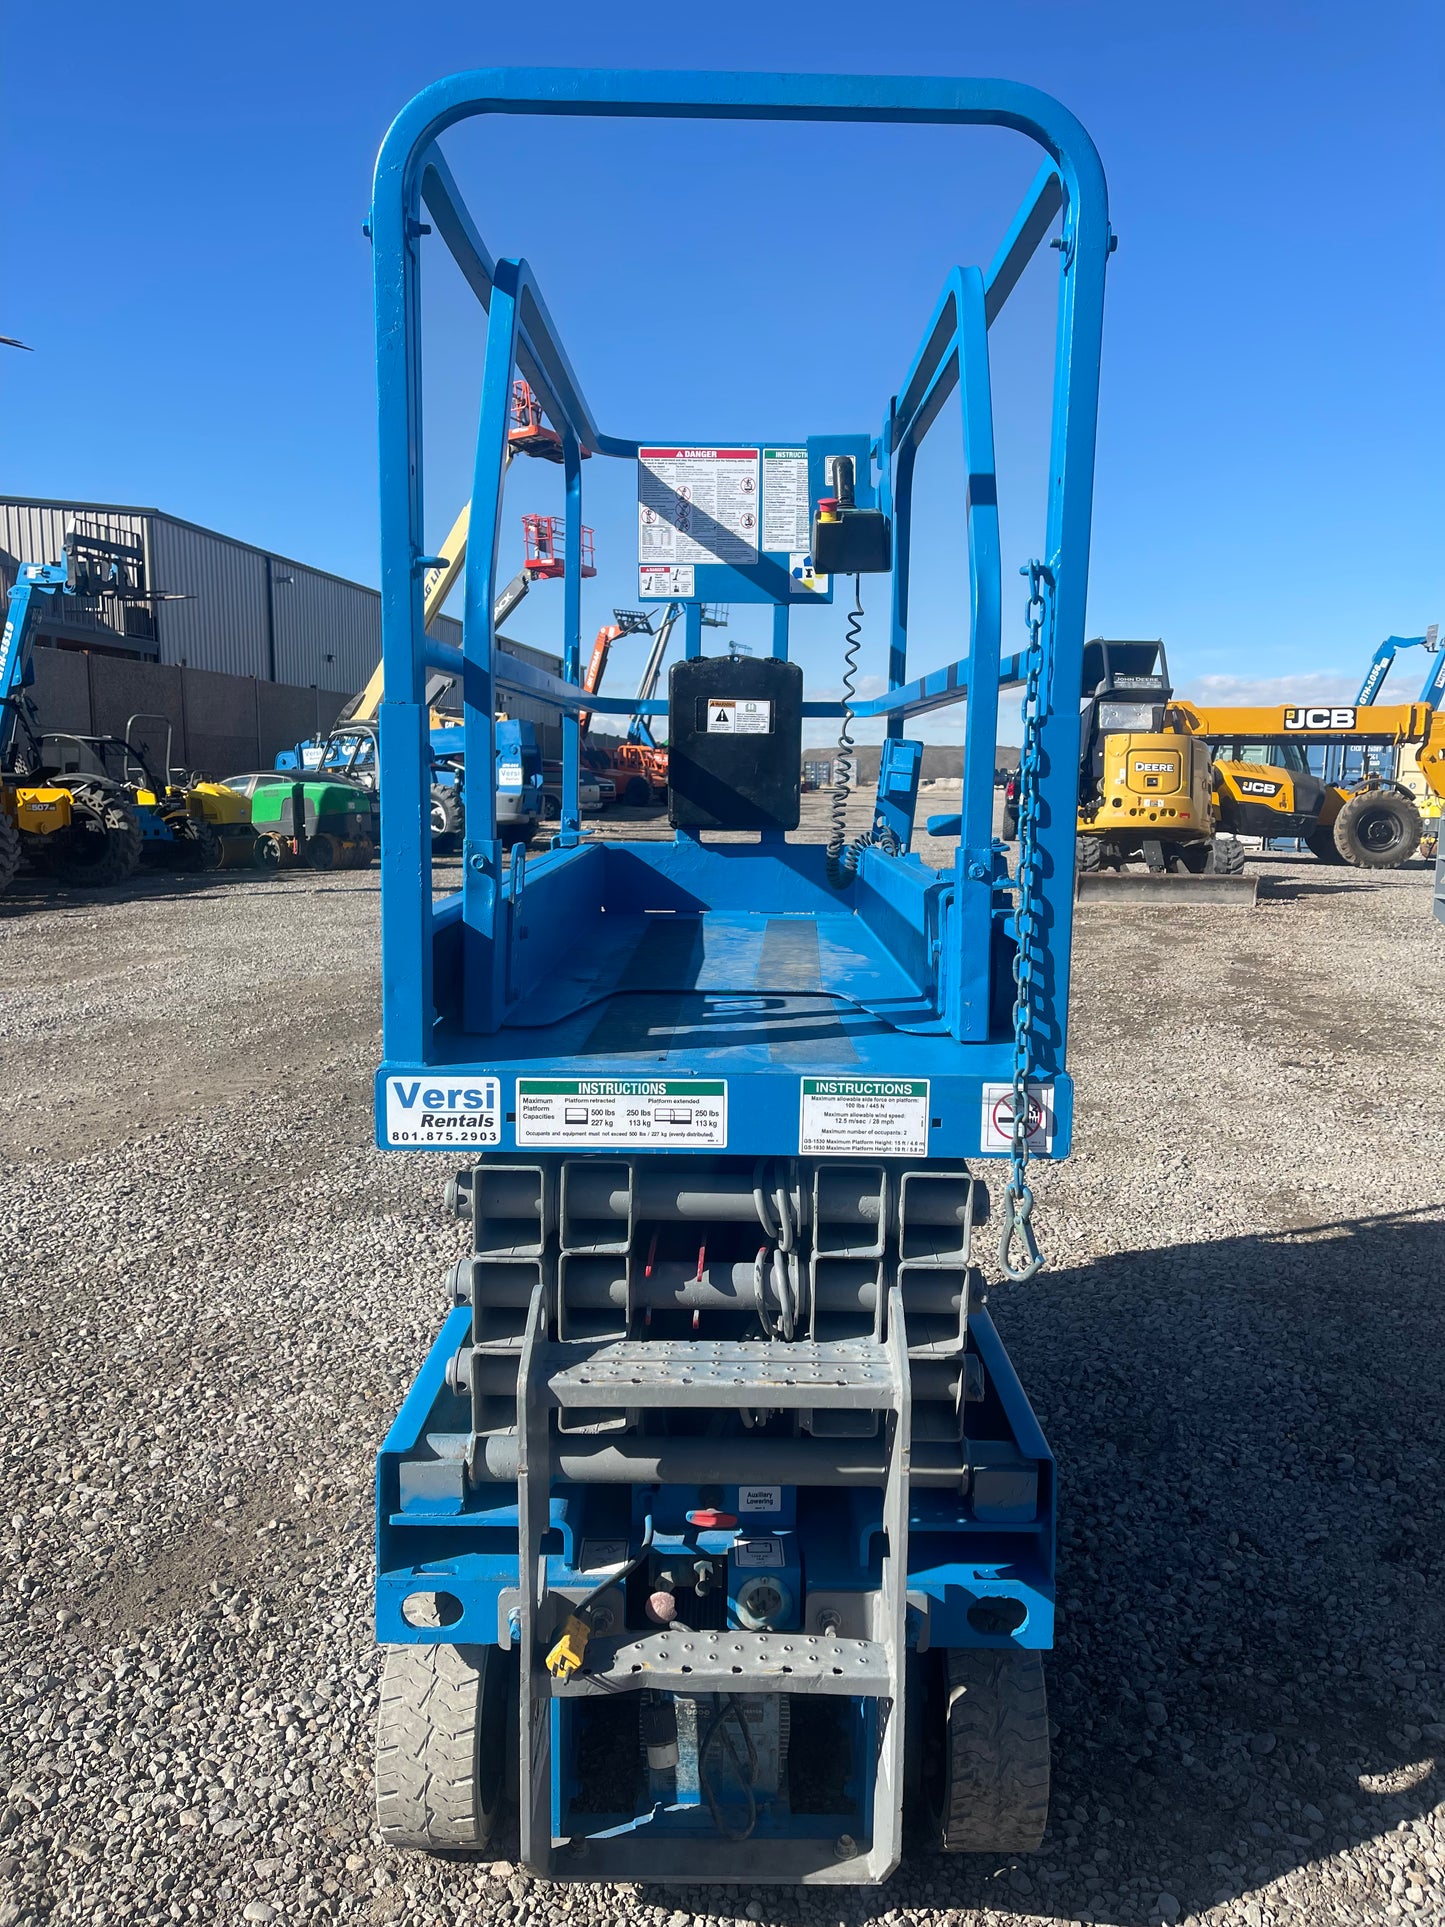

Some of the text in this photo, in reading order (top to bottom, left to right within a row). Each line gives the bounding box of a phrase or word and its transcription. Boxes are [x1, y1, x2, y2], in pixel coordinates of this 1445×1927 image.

[494, 592, 513, 621] ACK
[587, 649, 600, 688] SKYTRAK
[1360, 664, 1382, 704] GTH-1056
[1286, 709, 1354, 729] JCB
[1135, 762, 1174, 772] DEERE
[1242, 782, 1276, 794] JCB
[578, 1083, 666, 1094] INSTRUCTIONS
[816, 1082, 912, 1094] INSTRUCTIONS
[393, 1082, 494, 1109] Versi
[420, 1114, 494, 1127] Rentals
[392, 1132, 496, 1140] 801.875.2903
